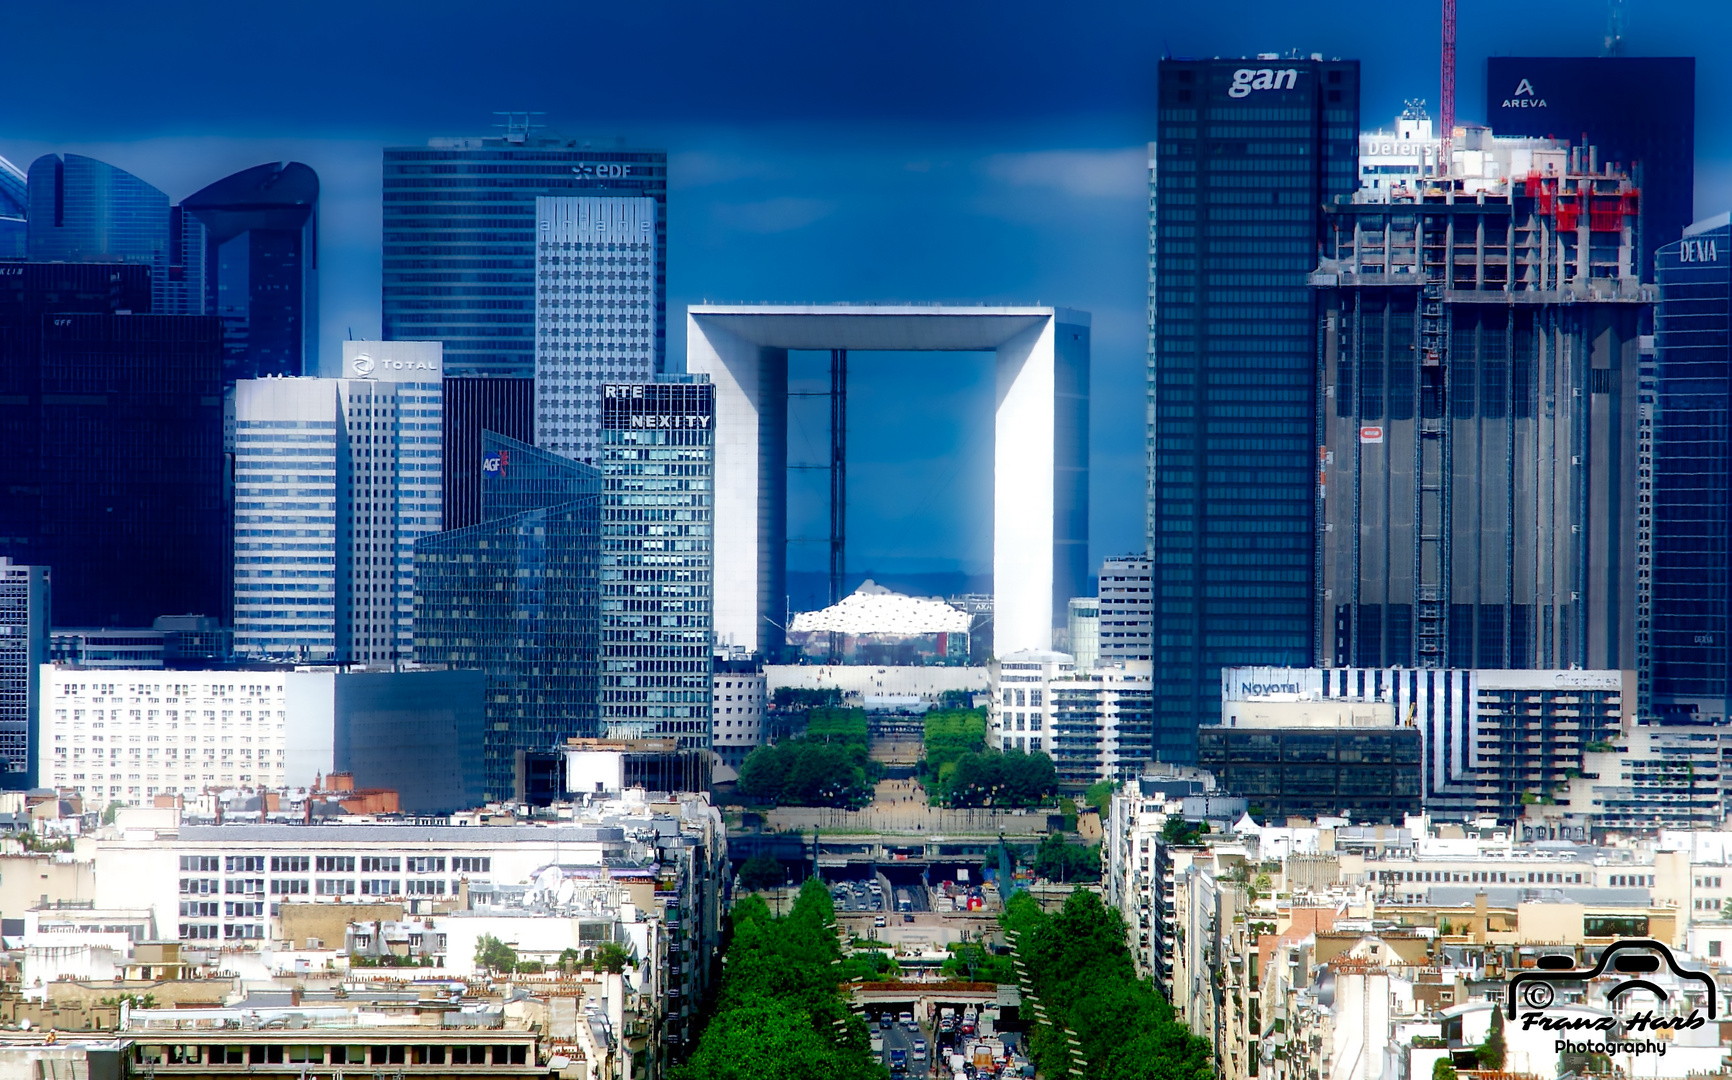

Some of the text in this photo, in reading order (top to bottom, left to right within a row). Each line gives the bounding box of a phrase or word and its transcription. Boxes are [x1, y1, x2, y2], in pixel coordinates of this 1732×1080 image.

[1228, 68, 1298, 98] gan
[1502, 99, 1547, 108] AREVA
[1368, 140, 1441, 156] Defens
[540, 213, 651, 231] ariane
[1680, 240, 1718, 262] DEXIA
[382, 359, 437, 370] TOTAL
[605, 386, 643, 398] RTE
[631, 415, 710, 427] NEXITY
[483, 458, 501, 471] AGF
